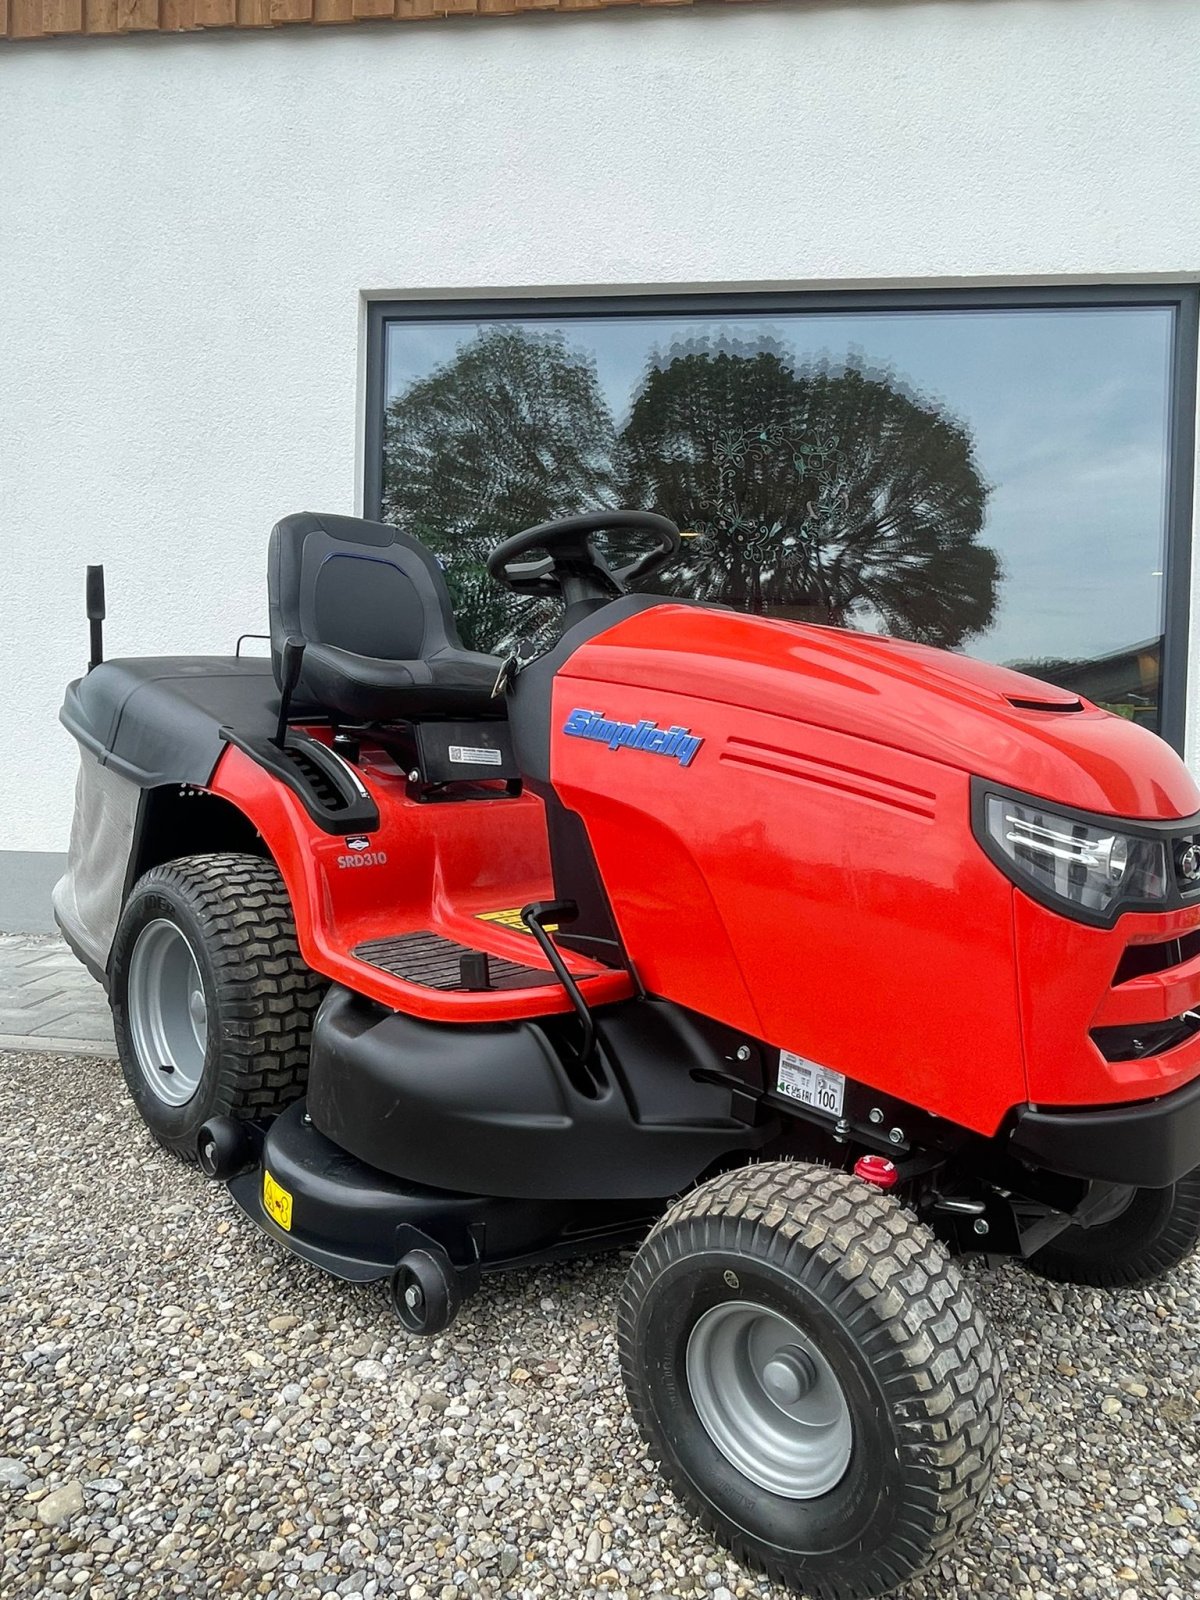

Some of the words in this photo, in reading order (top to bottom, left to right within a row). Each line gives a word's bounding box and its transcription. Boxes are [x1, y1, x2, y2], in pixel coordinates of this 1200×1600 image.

[563, 707, 705, 767] Simplicity
[337, 851, 387, 869] SRD310
[818, 1088, 836, 1110] 100
